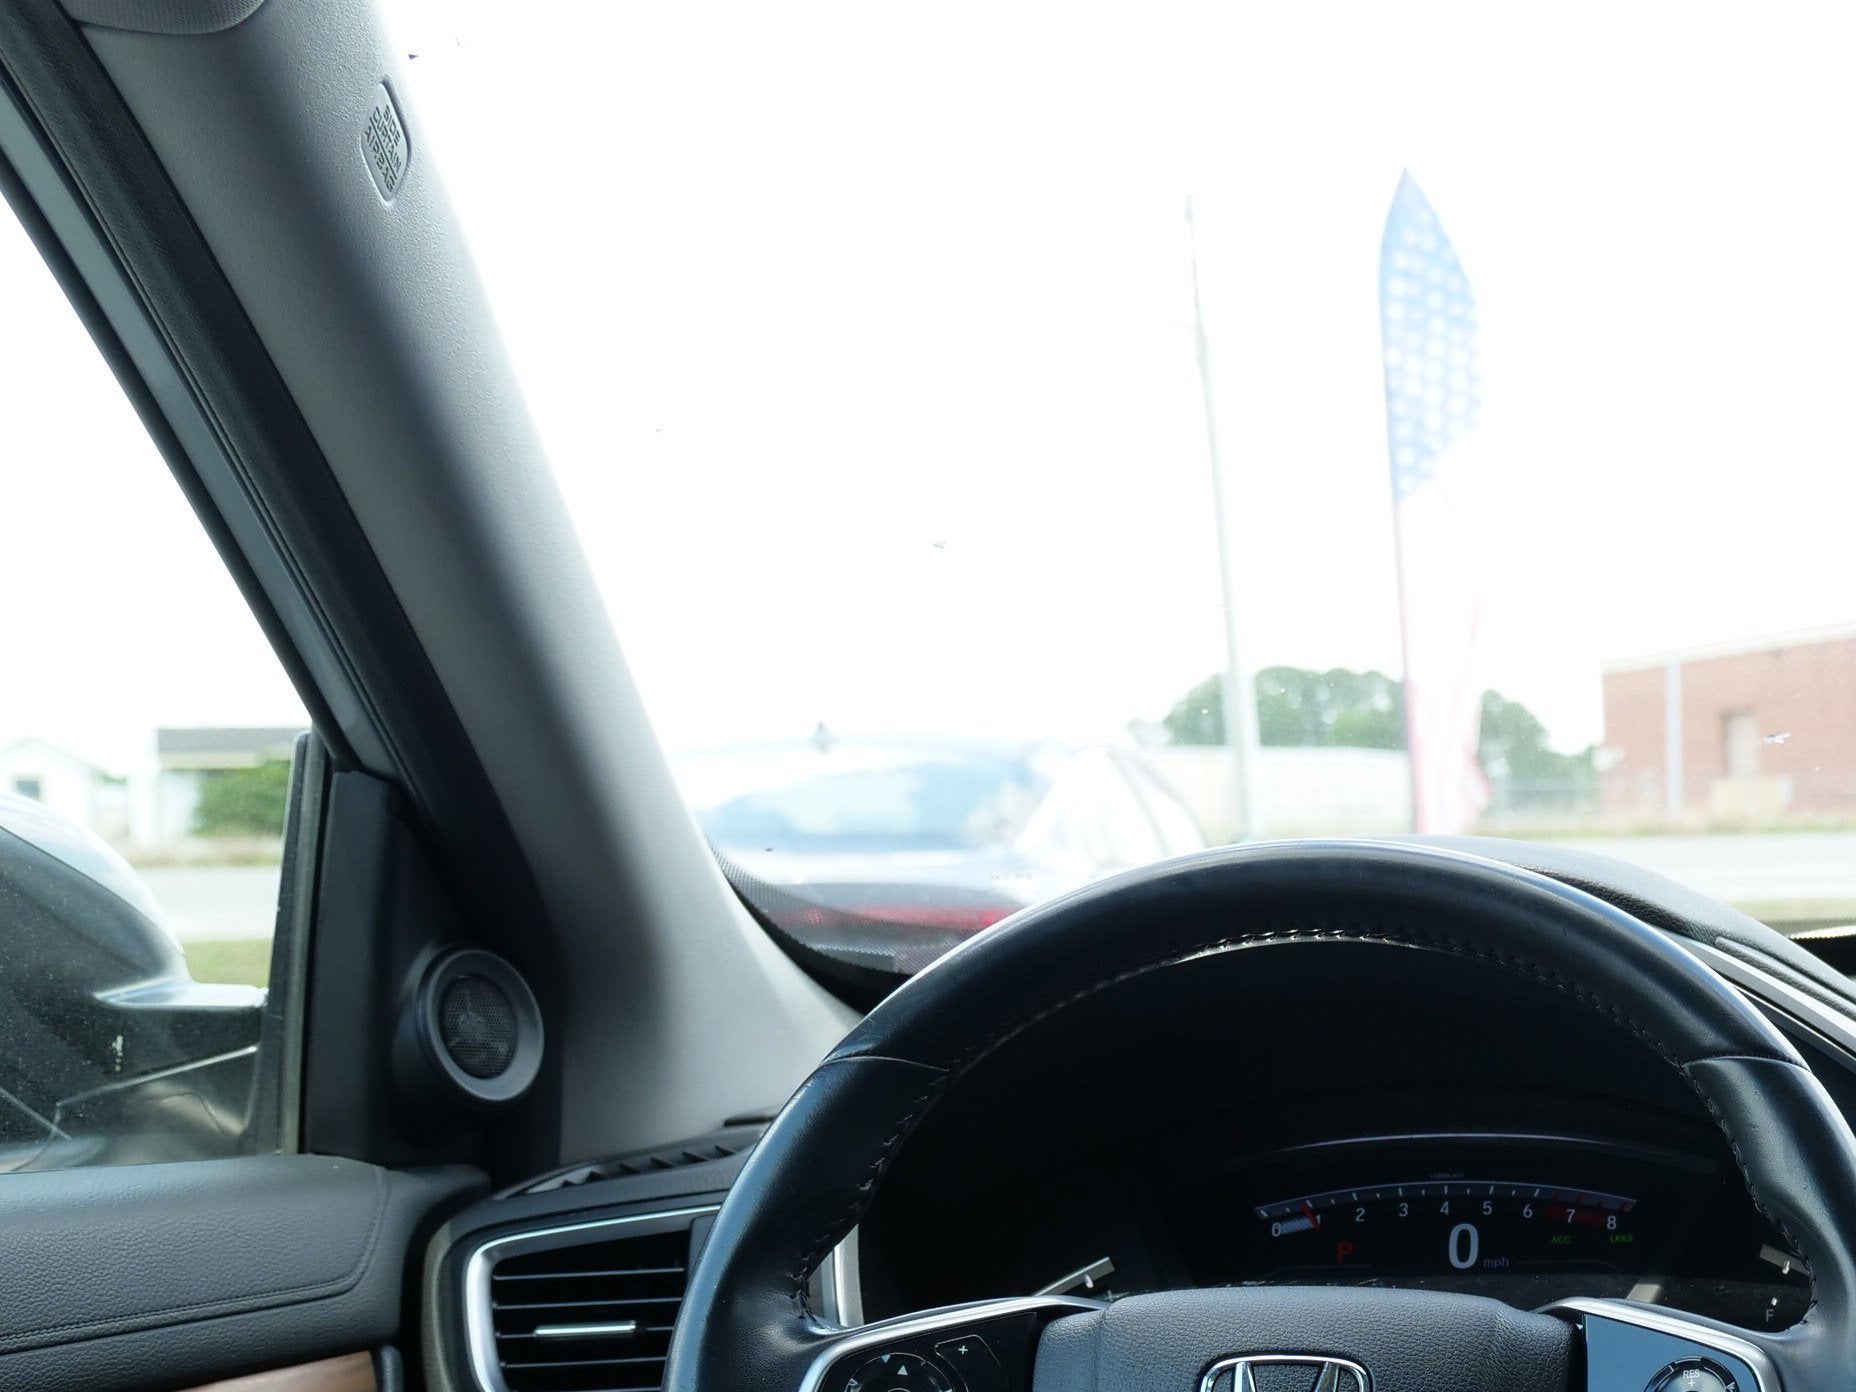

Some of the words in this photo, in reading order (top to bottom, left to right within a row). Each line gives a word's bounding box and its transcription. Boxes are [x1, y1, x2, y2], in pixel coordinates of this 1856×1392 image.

[365, 126, 395, 193] AIRBAG
[1355, 1207, 1366, 1222] 2
[1399, 1203, 1409, 1217] 3
[1440, 1201, 1450, 1215] 4
[1482, 1201, 1493, 1216] 5
[1523, 1204, 1533, 1219] 6
[1566, 1209, 1576, 1224] 7
[1606, 1215, 1618, 1230] 8
[1448, 1222, 1480, 1270] 0
[1483, 1257, 1510, 1270] mph
[1551, 1235, 1571, 1245] ACC
[1610, 1234, 1634, 1244] LKAS
[1337, 1241, 1356, 1264] P
[1765, 1309, 1774, 1322] F
[1683, 1369, 1700, 1380] RES
